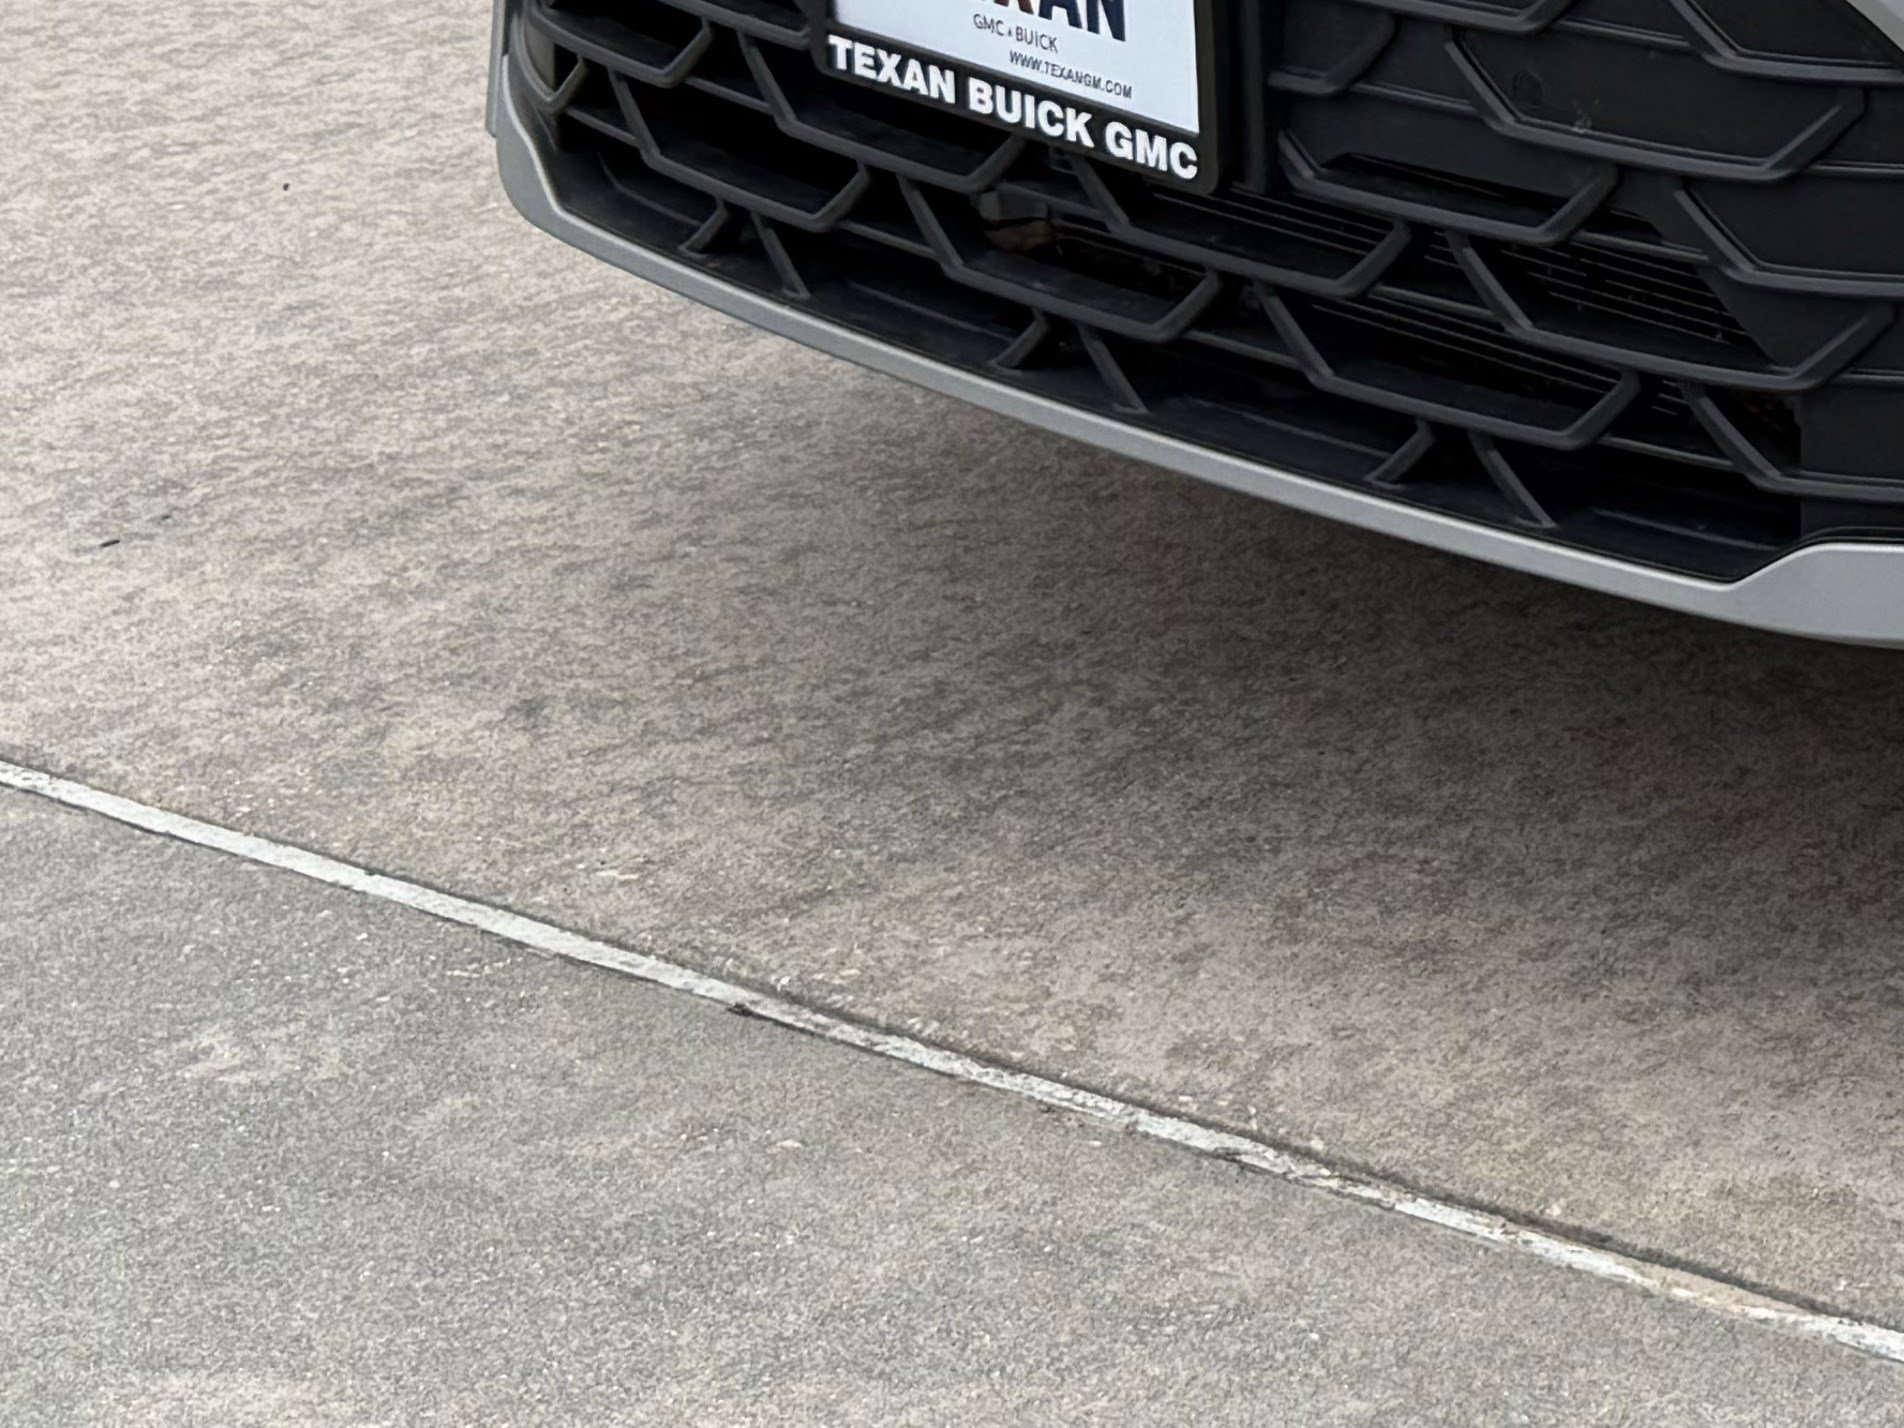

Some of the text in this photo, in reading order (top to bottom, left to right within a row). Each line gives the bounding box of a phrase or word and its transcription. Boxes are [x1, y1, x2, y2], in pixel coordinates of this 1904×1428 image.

[973, 13, 1059, 54] GMC BUICK
[1009, 49, 1133, 99] WWW.TEXANGM.COM
[827, 34, 1199, 181] TEXAN BUICK GMC
